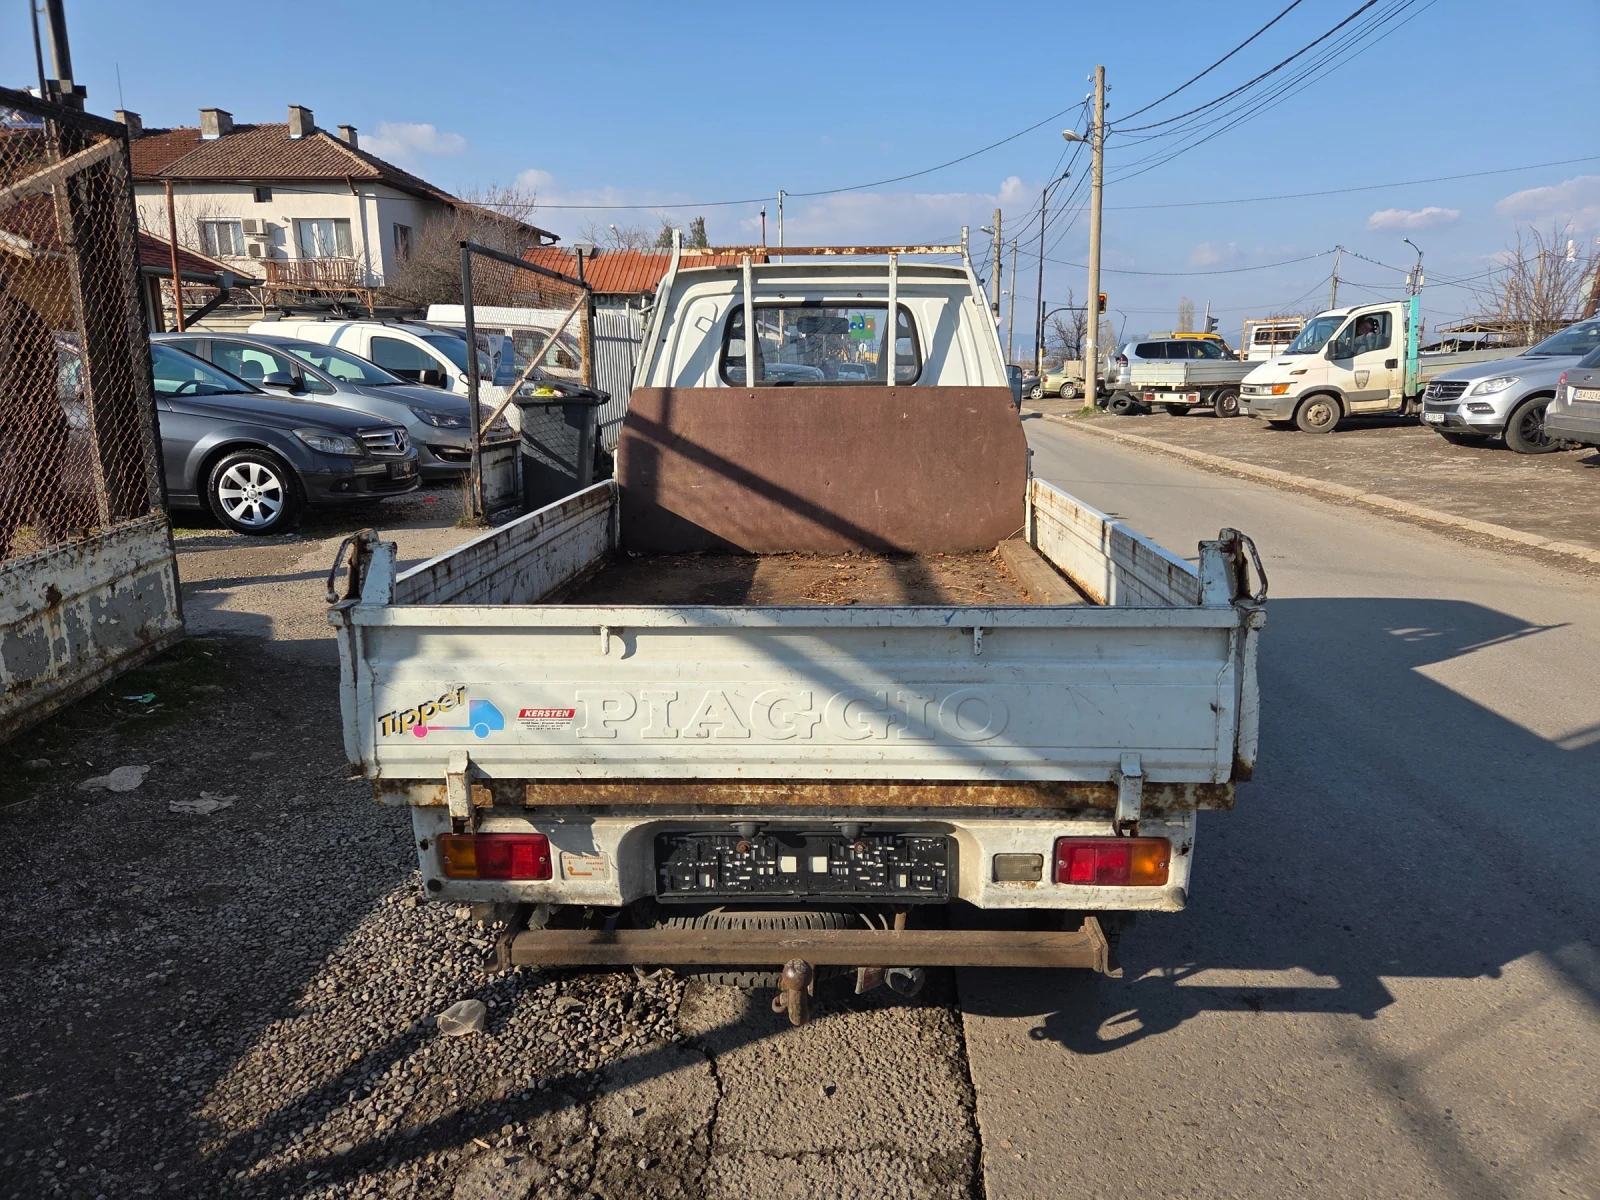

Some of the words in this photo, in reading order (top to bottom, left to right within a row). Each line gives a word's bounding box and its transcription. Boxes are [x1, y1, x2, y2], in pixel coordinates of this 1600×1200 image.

[377, 685, 467, 737] Tipper
[524, 709, 571, 718] KERSTEN
[575, 687, 1010, 742] PIAGGIO
